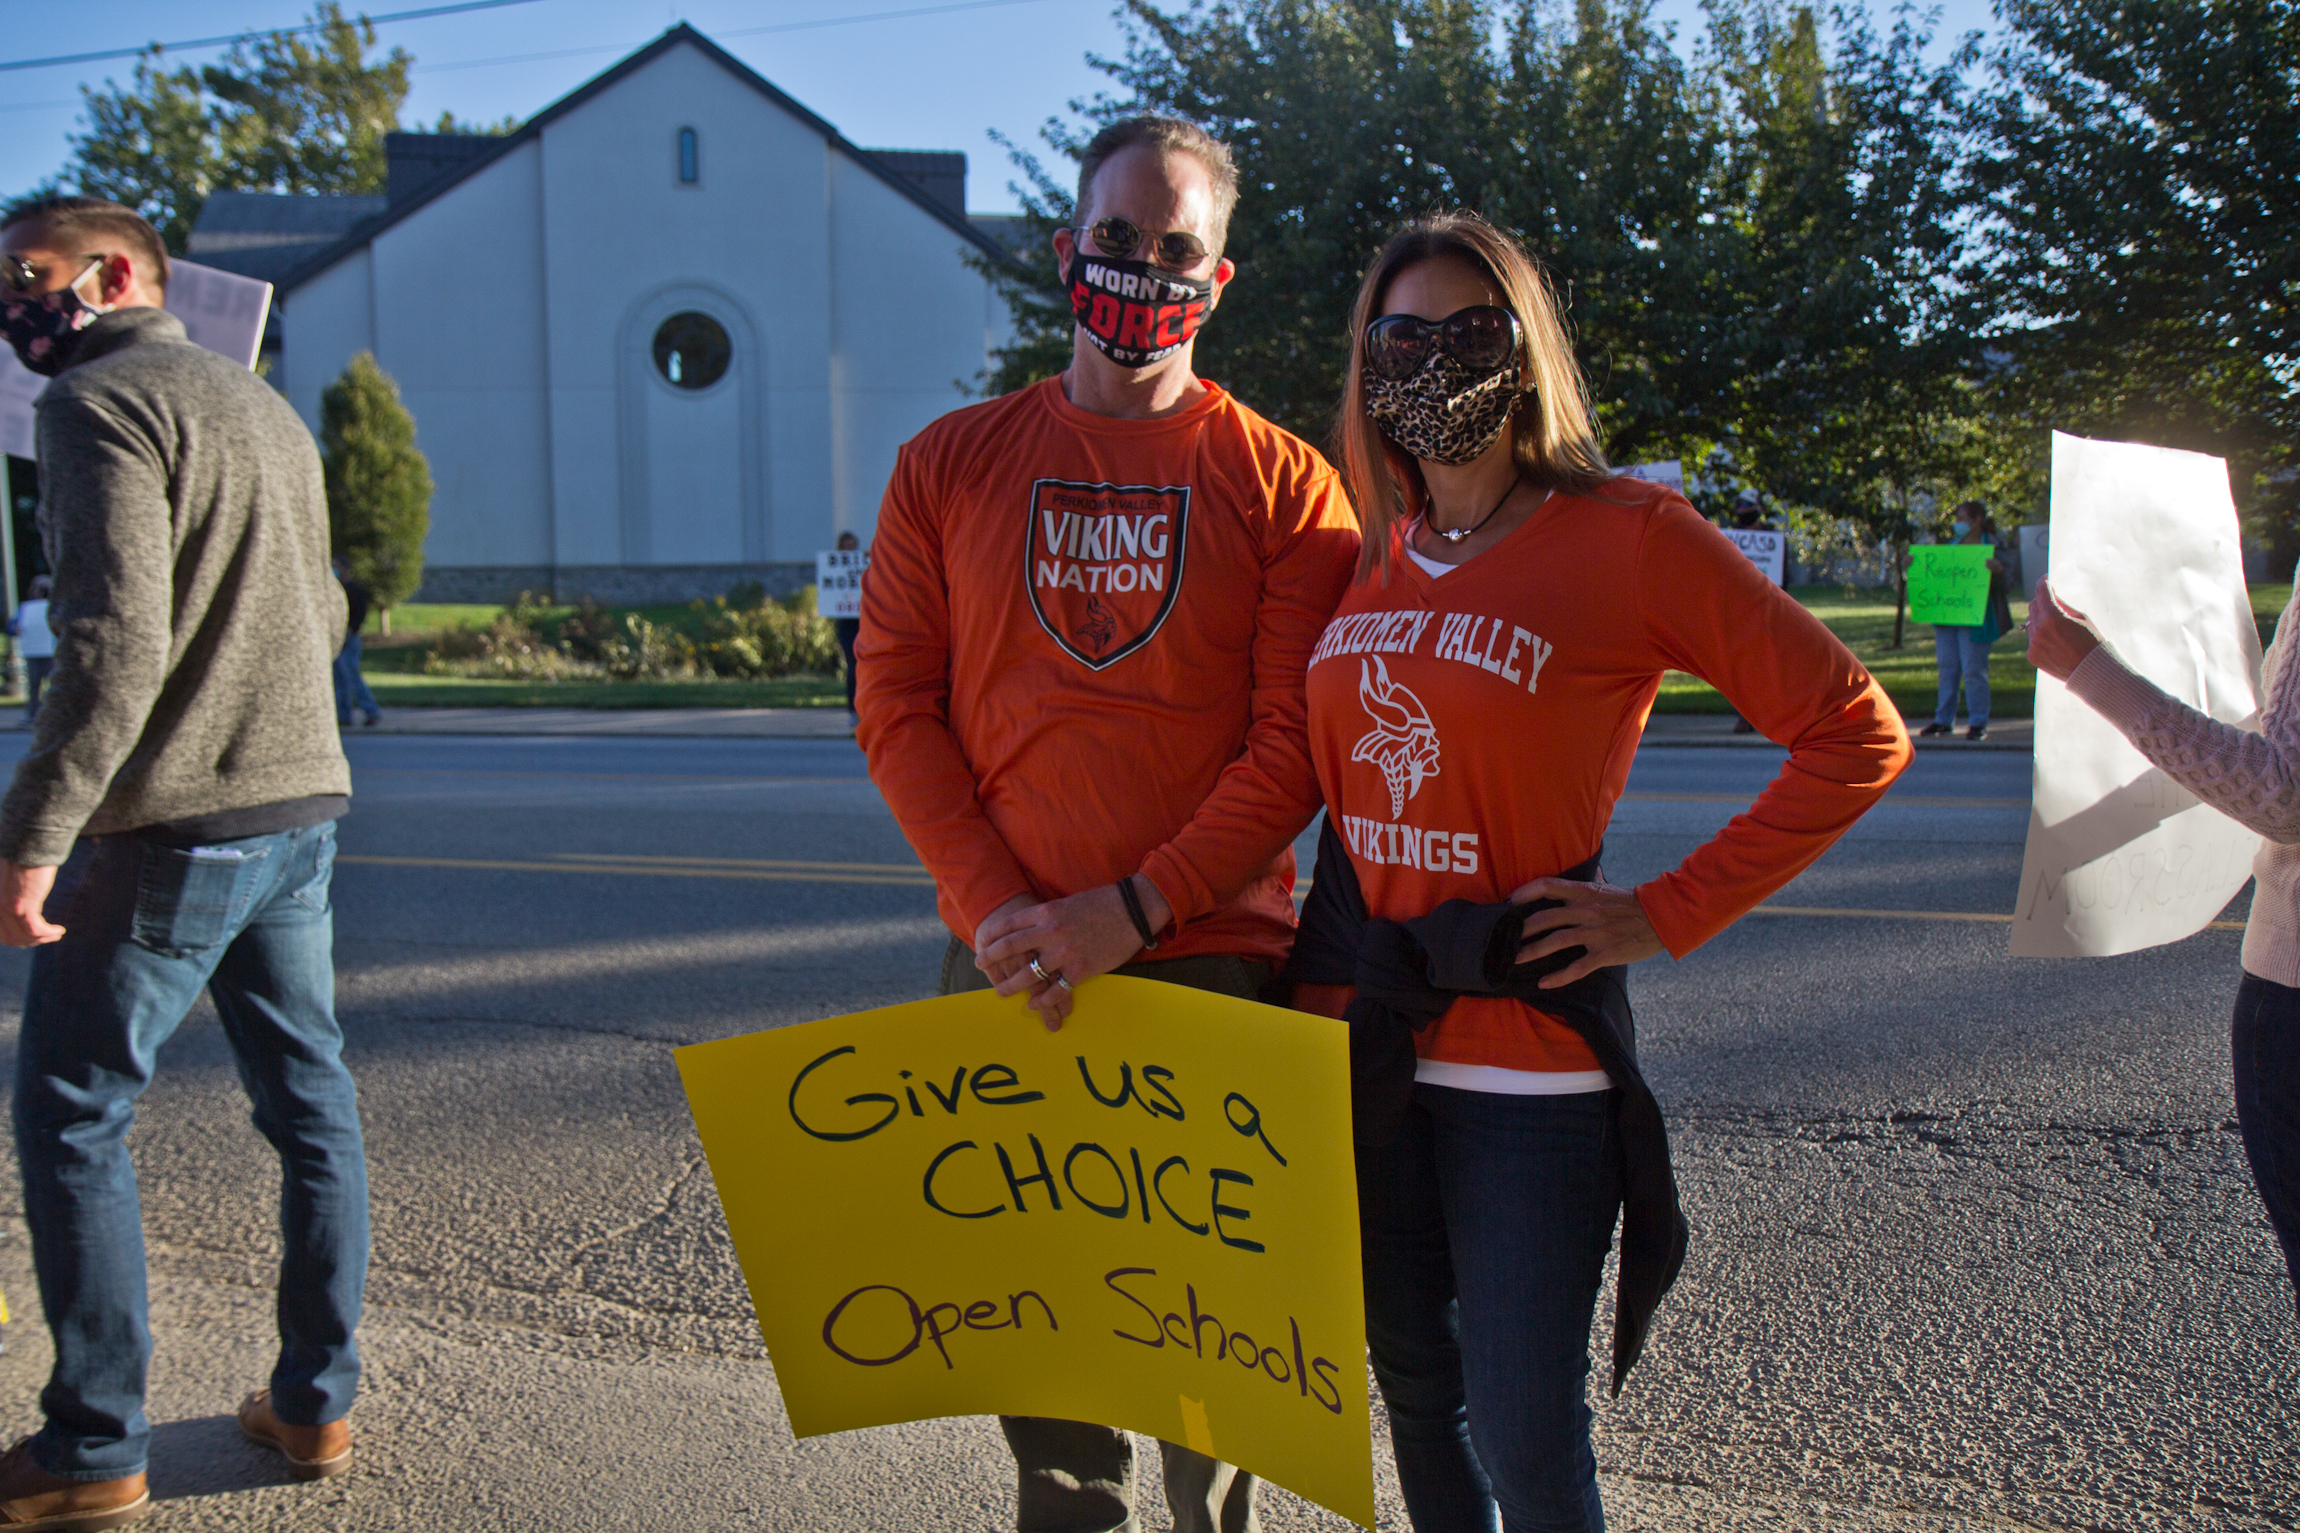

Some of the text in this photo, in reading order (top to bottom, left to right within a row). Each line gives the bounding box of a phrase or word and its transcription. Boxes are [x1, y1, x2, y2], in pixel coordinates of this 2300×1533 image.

[1085, 263, 1160, 301] WORN
[1071, 280, 1206, 350] FORCE
[1113, 348, 1139, 361] BY
[1119, 499, 1165, 511] VALLEY
[1042, 509, 1168, 560] VIKING
[1036, 559, 1164, 593] NATION
[1924, 552, 1978, 588] Reopen
[1917, 588, 1974, 608] Schools
[1435, 612, 1553, 695] VALLEY
[1342, 815, 1479, 875] VIKINGS
[789, 1046, 1287, 1167] Give us a
[923, 1133, 1265, 1253] CHOICE
[823, 1267, 1342, 1414] Open Schools
